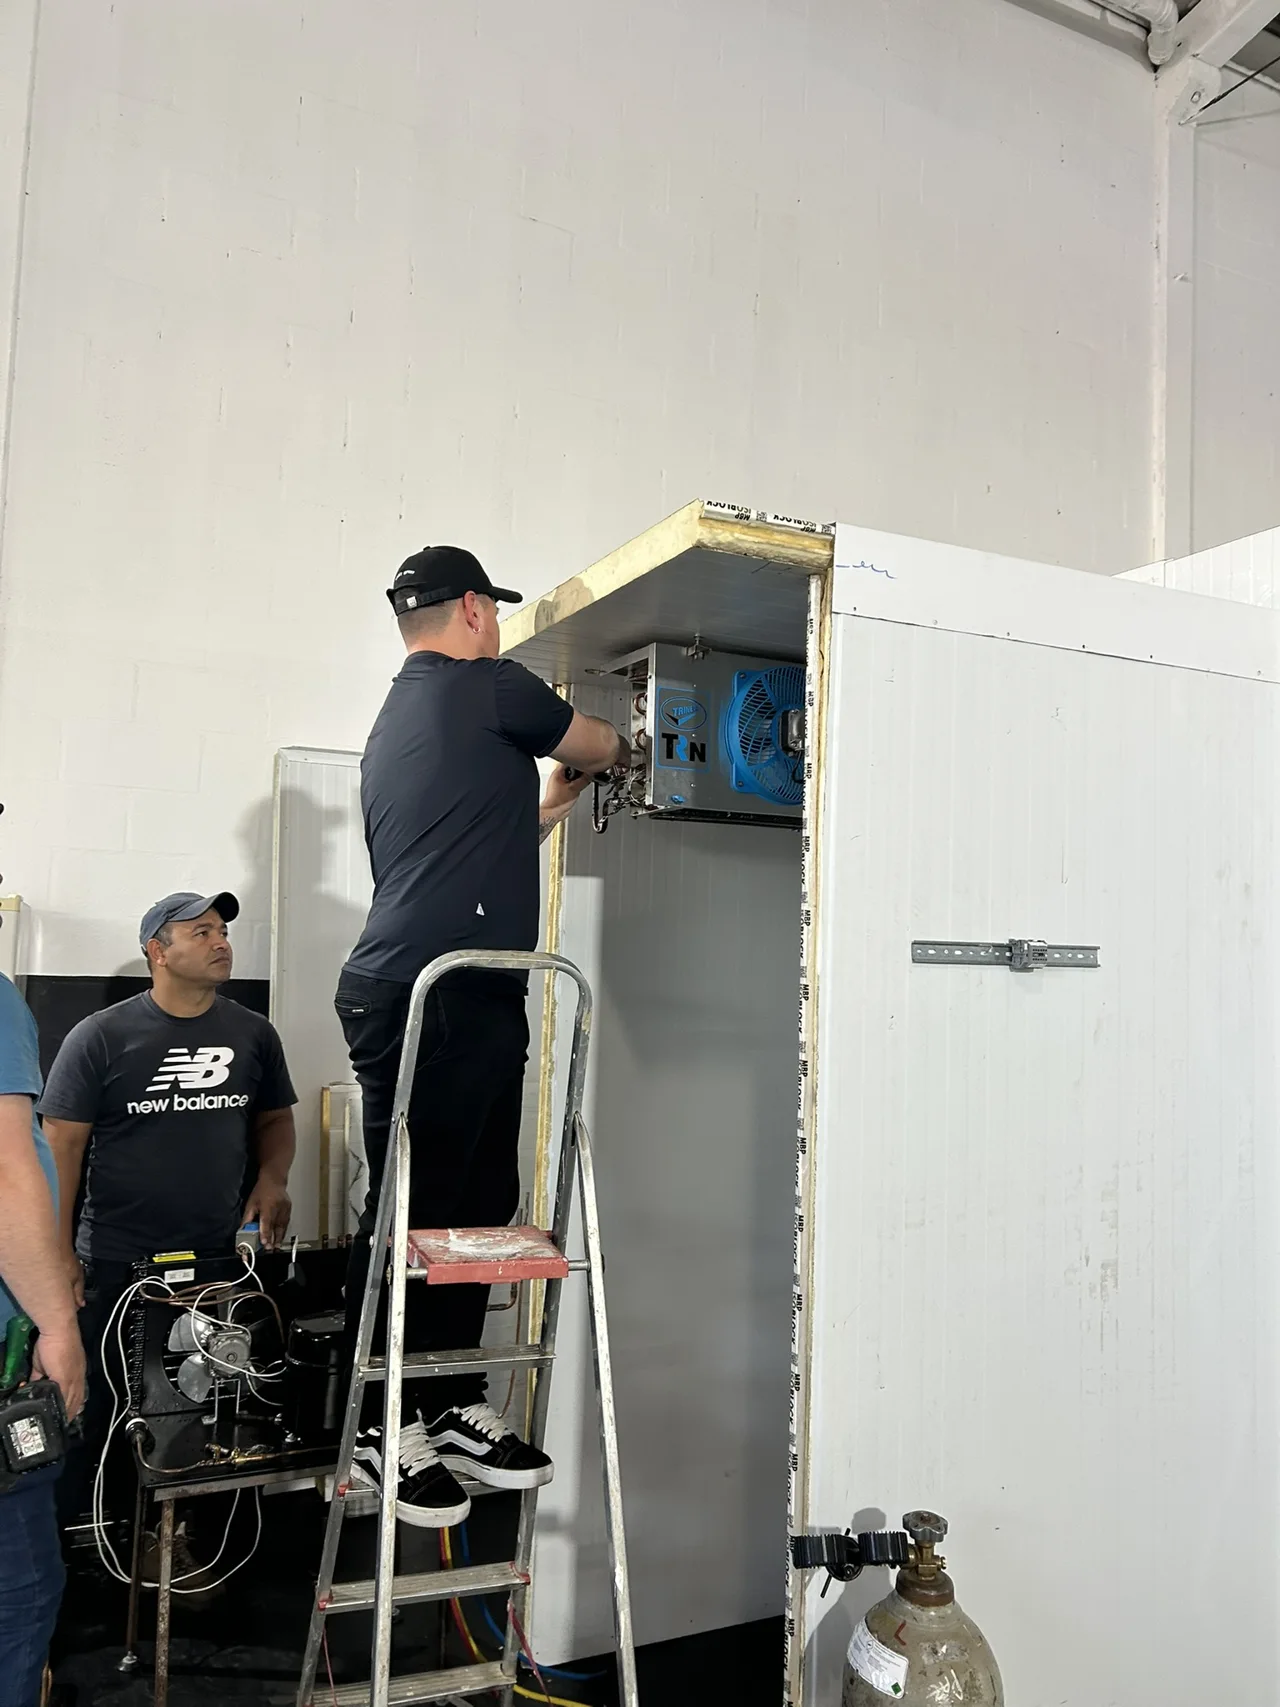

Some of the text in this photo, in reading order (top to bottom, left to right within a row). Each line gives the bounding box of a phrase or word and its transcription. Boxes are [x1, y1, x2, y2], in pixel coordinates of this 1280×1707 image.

[672, 705, 699, 717] TRINE
[662, 732, 706, 763] TRN
[145, 1046, 235, 1092] NB
[127, 1093, 249, 1114] new balance
